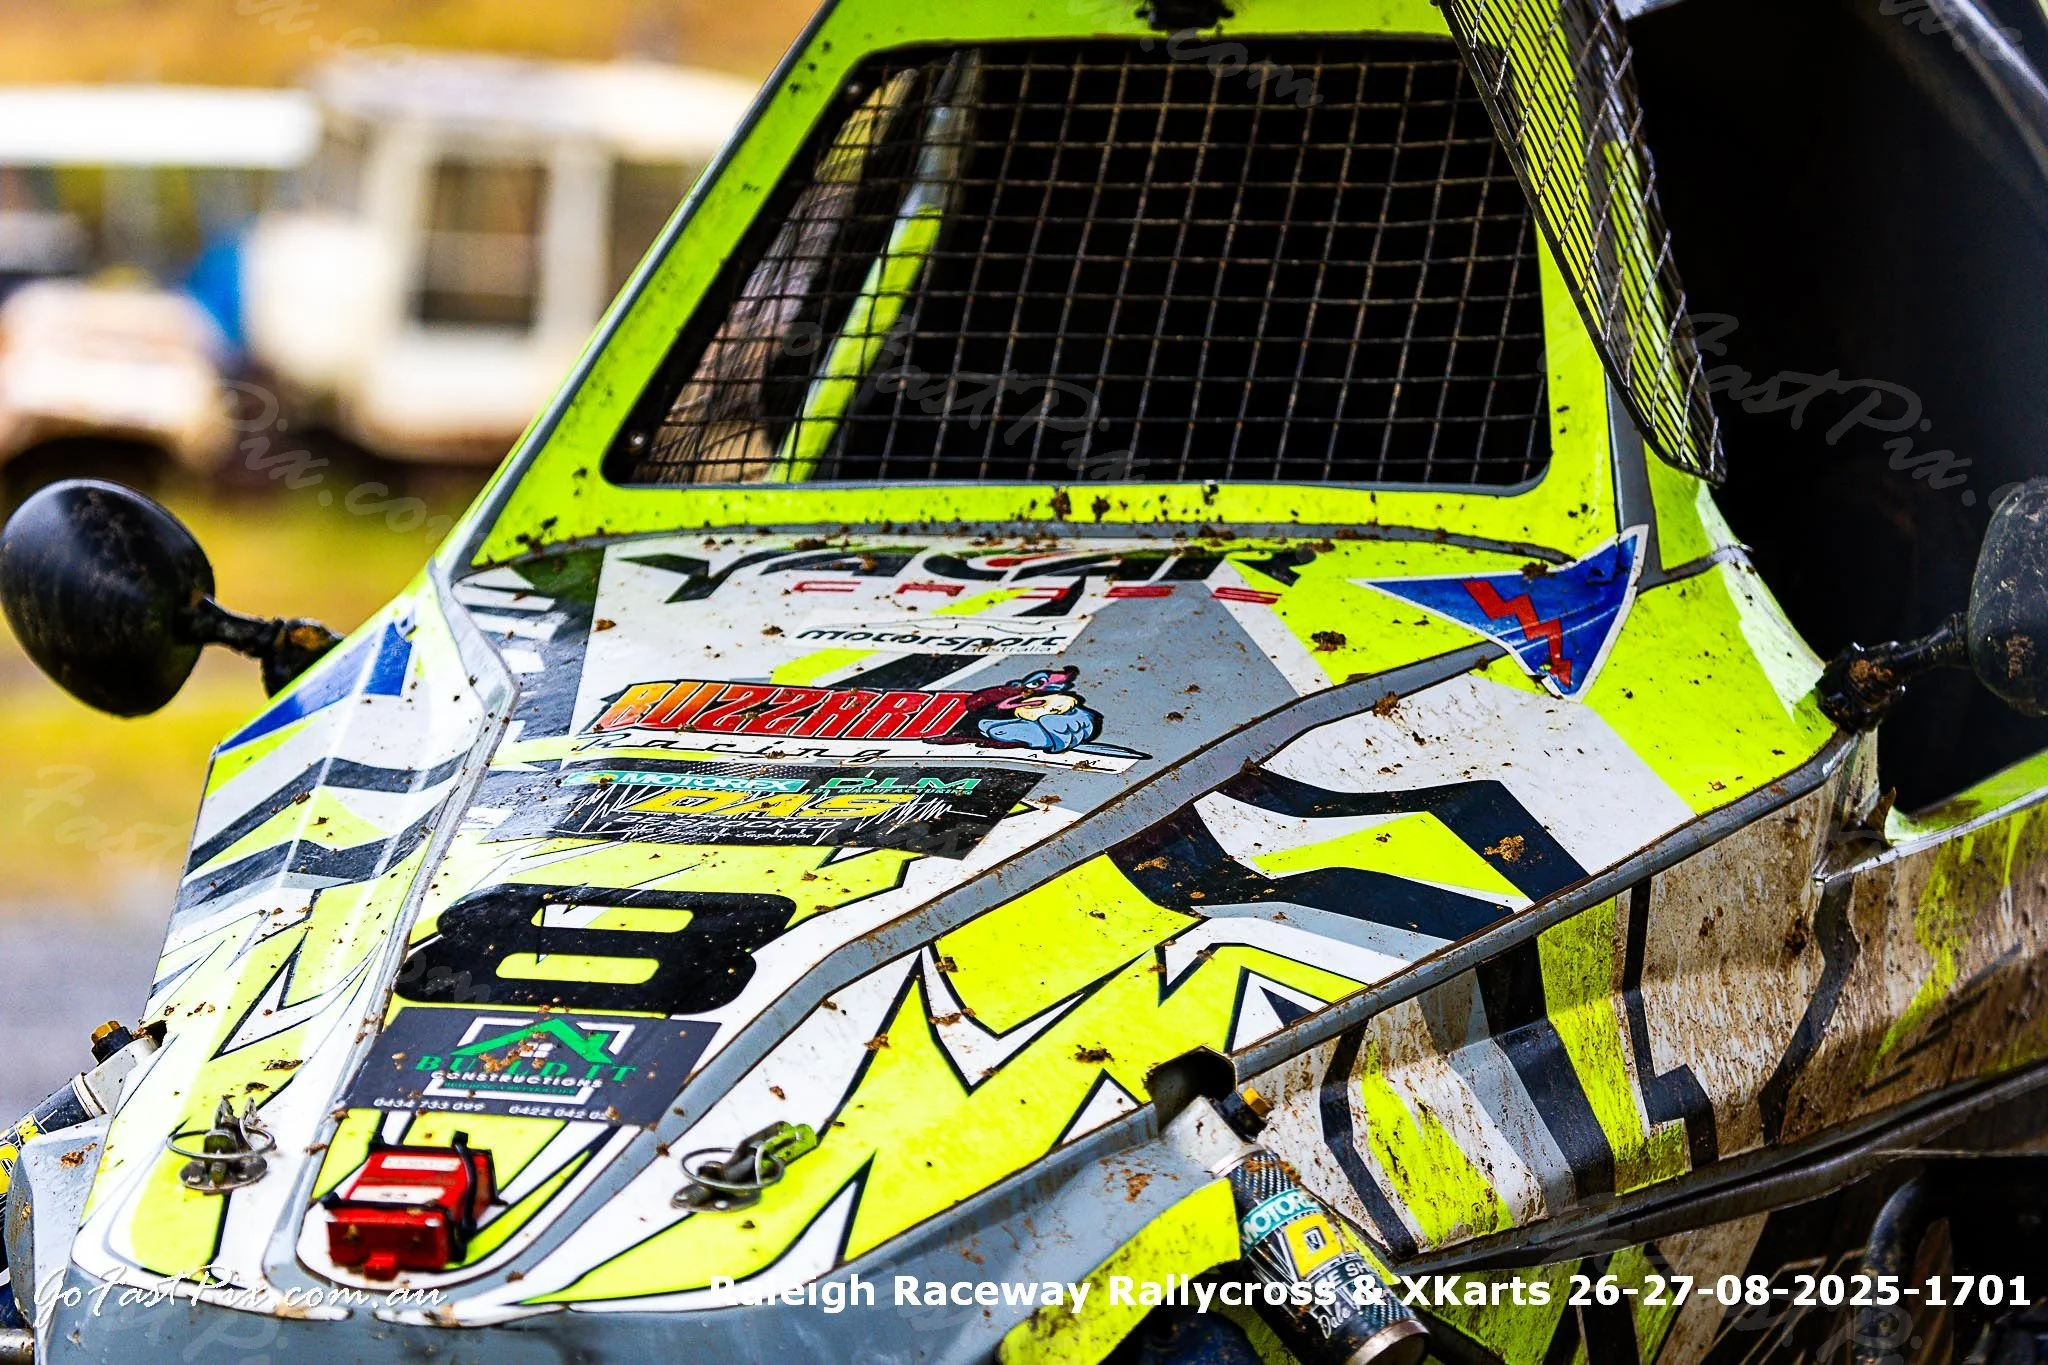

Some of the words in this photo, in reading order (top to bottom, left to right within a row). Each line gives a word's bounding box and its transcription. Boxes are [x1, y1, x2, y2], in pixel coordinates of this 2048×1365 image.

[795, 628, 1067, 652] motorsport
[599, 681, 973, 741] BUZZARD
[574, 733, 890, 763] Racing
[618, 774, 798, 791] MOTOREX
[818, 777, 982, 790] DLM
[393, 882, 797, 1016] 8
[415, 1055, 569, 1077] BULD
[583, 1063, 638, 1082] IT
[430, 1069, 604, 1089] CONSTRUCTIONS
[373, 1097, 416, 1108] 0434
[419, 1100, 449, 1110] 733
[452, 1103, 485, 1112] 099
[508, 1105, 552, 1117] 0422
